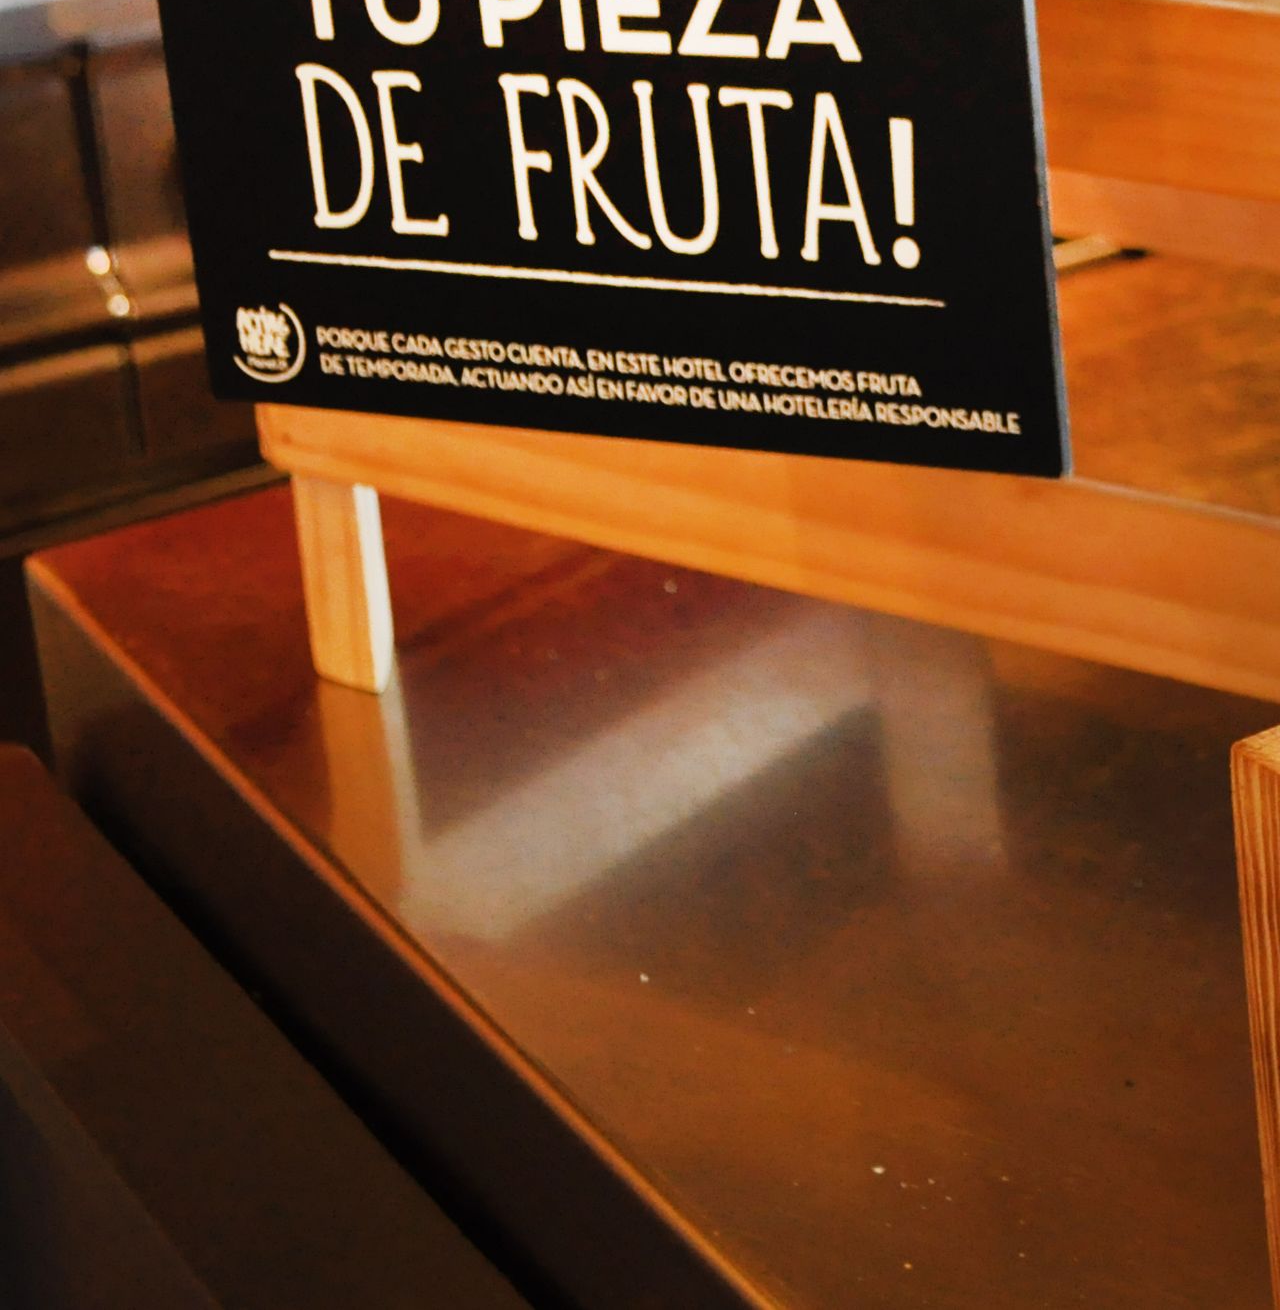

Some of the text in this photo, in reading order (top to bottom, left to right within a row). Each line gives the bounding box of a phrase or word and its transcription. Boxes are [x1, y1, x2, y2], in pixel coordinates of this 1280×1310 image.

[294, 63, 921, 270] DE FRUTA!
[316, 326, 390, 352] PORQUE
[392, 333, 445, 357] CADA
[444, 338, 507, 362] GESTO
[587, 349, 614, 371] EN
[615, 351, 662, 376] ESTE
[663, 357, 729, 382] HOTEL
[728, 362, 856, 390] OFRECEMOS
[857, 371, 922, 397] FRUTA
[320, 353, 347, 375] DE
[461, 367, 564, 395] ACTUANDO
[566, 371, 595, 398] ASÍ
[597, 378, 624, 400] EN
[625, 380, 688, 405] FAVOR
[689, 386, 716, 409] DE
[718, 390, 762, 412] UNA
[763, 393, 873, 421] HOTELERÍA
[875, 402, 1020, 434] RESPONSABLE
